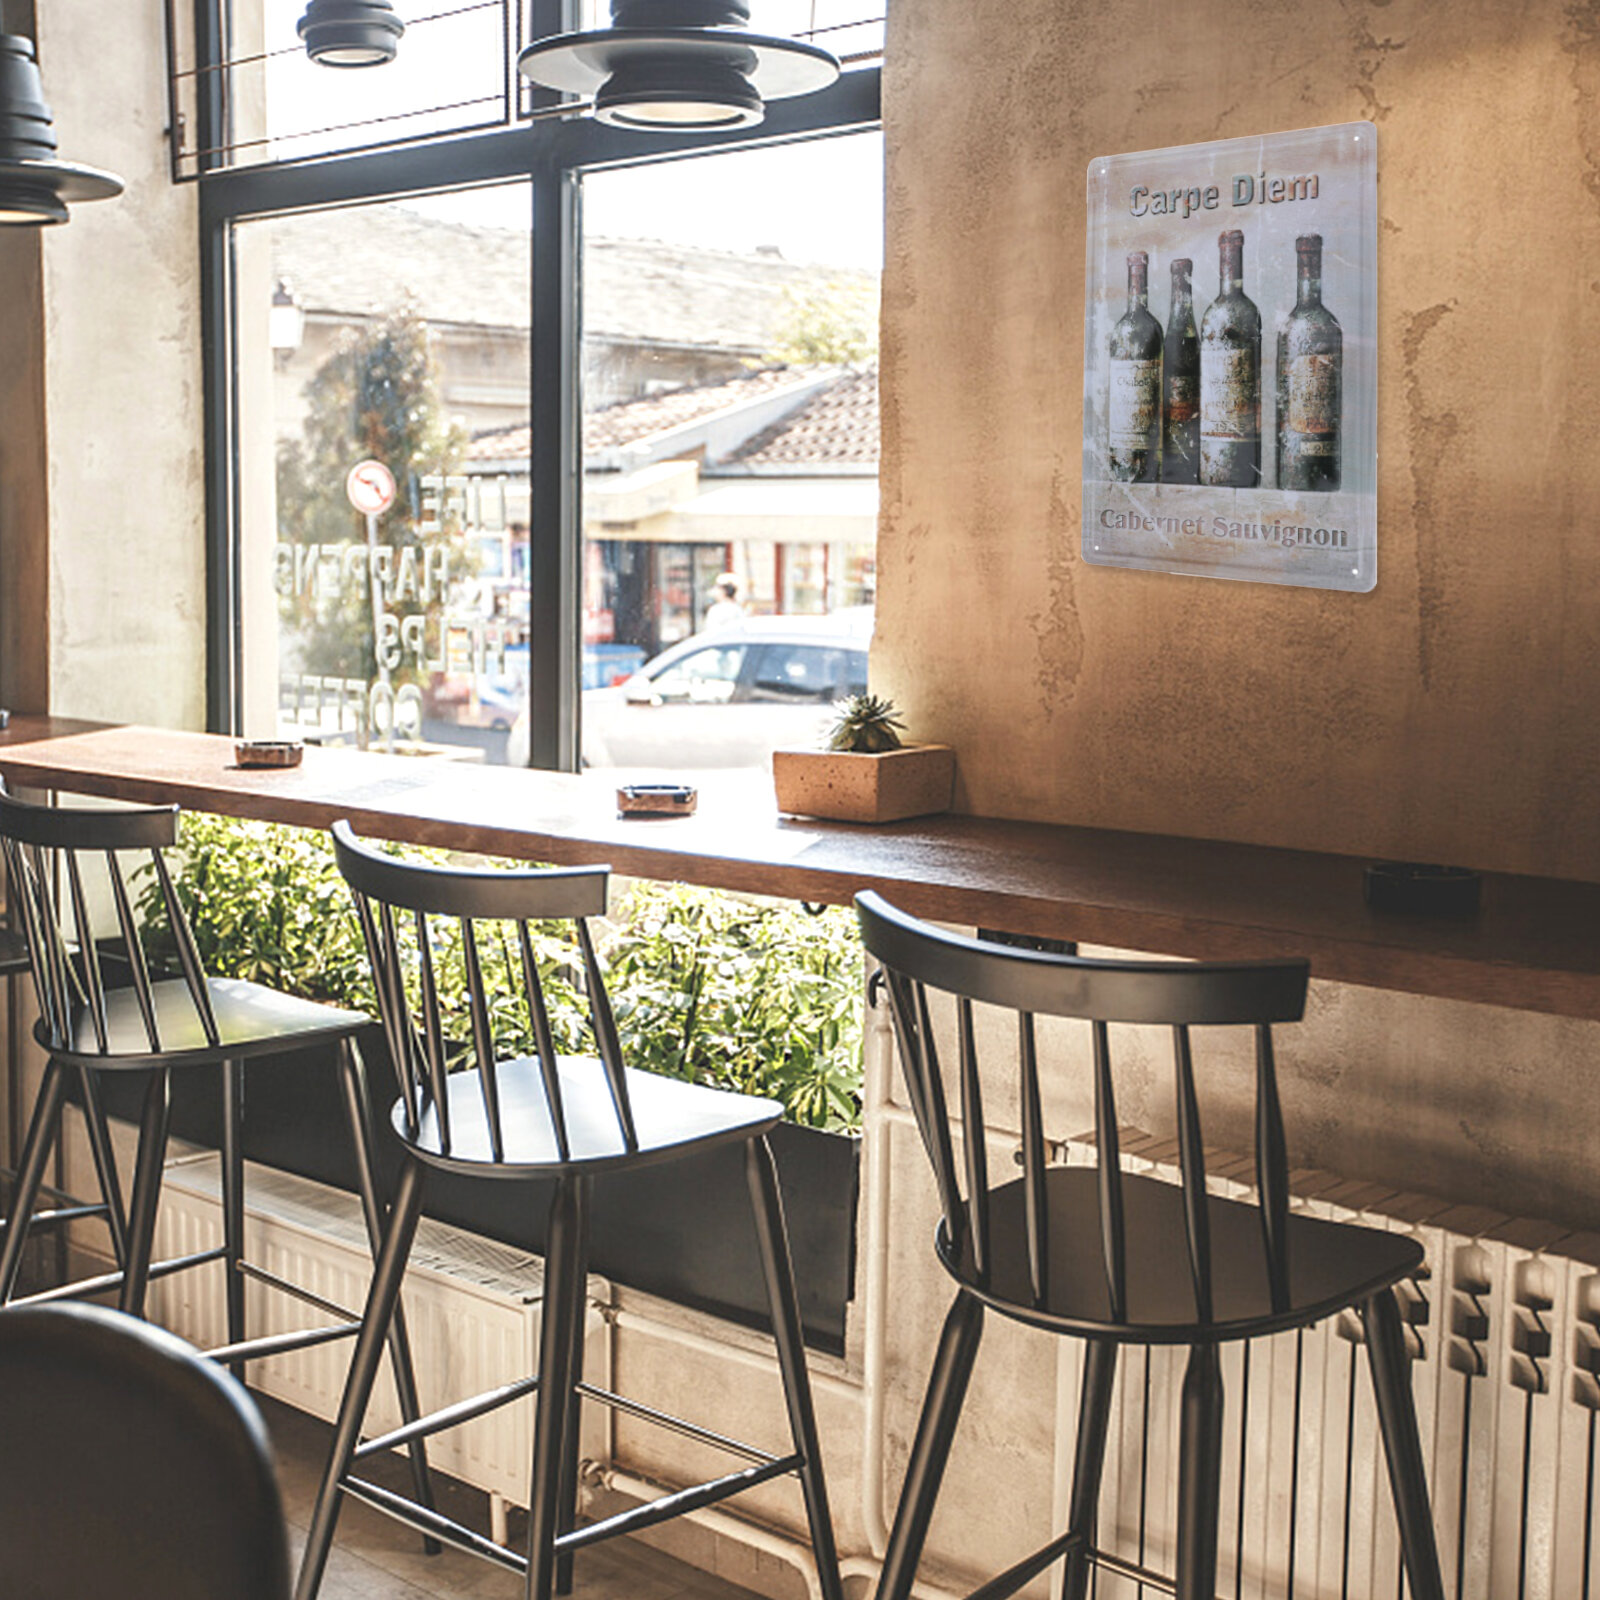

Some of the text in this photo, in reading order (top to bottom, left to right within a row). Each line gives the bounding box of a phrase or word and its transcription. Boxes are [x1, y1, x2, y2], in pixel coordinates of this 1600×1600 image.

[1129, 171, 1320, 219] Carpe Diem
[1100, 508, 1349, 548] Cabernet Sauvignon
